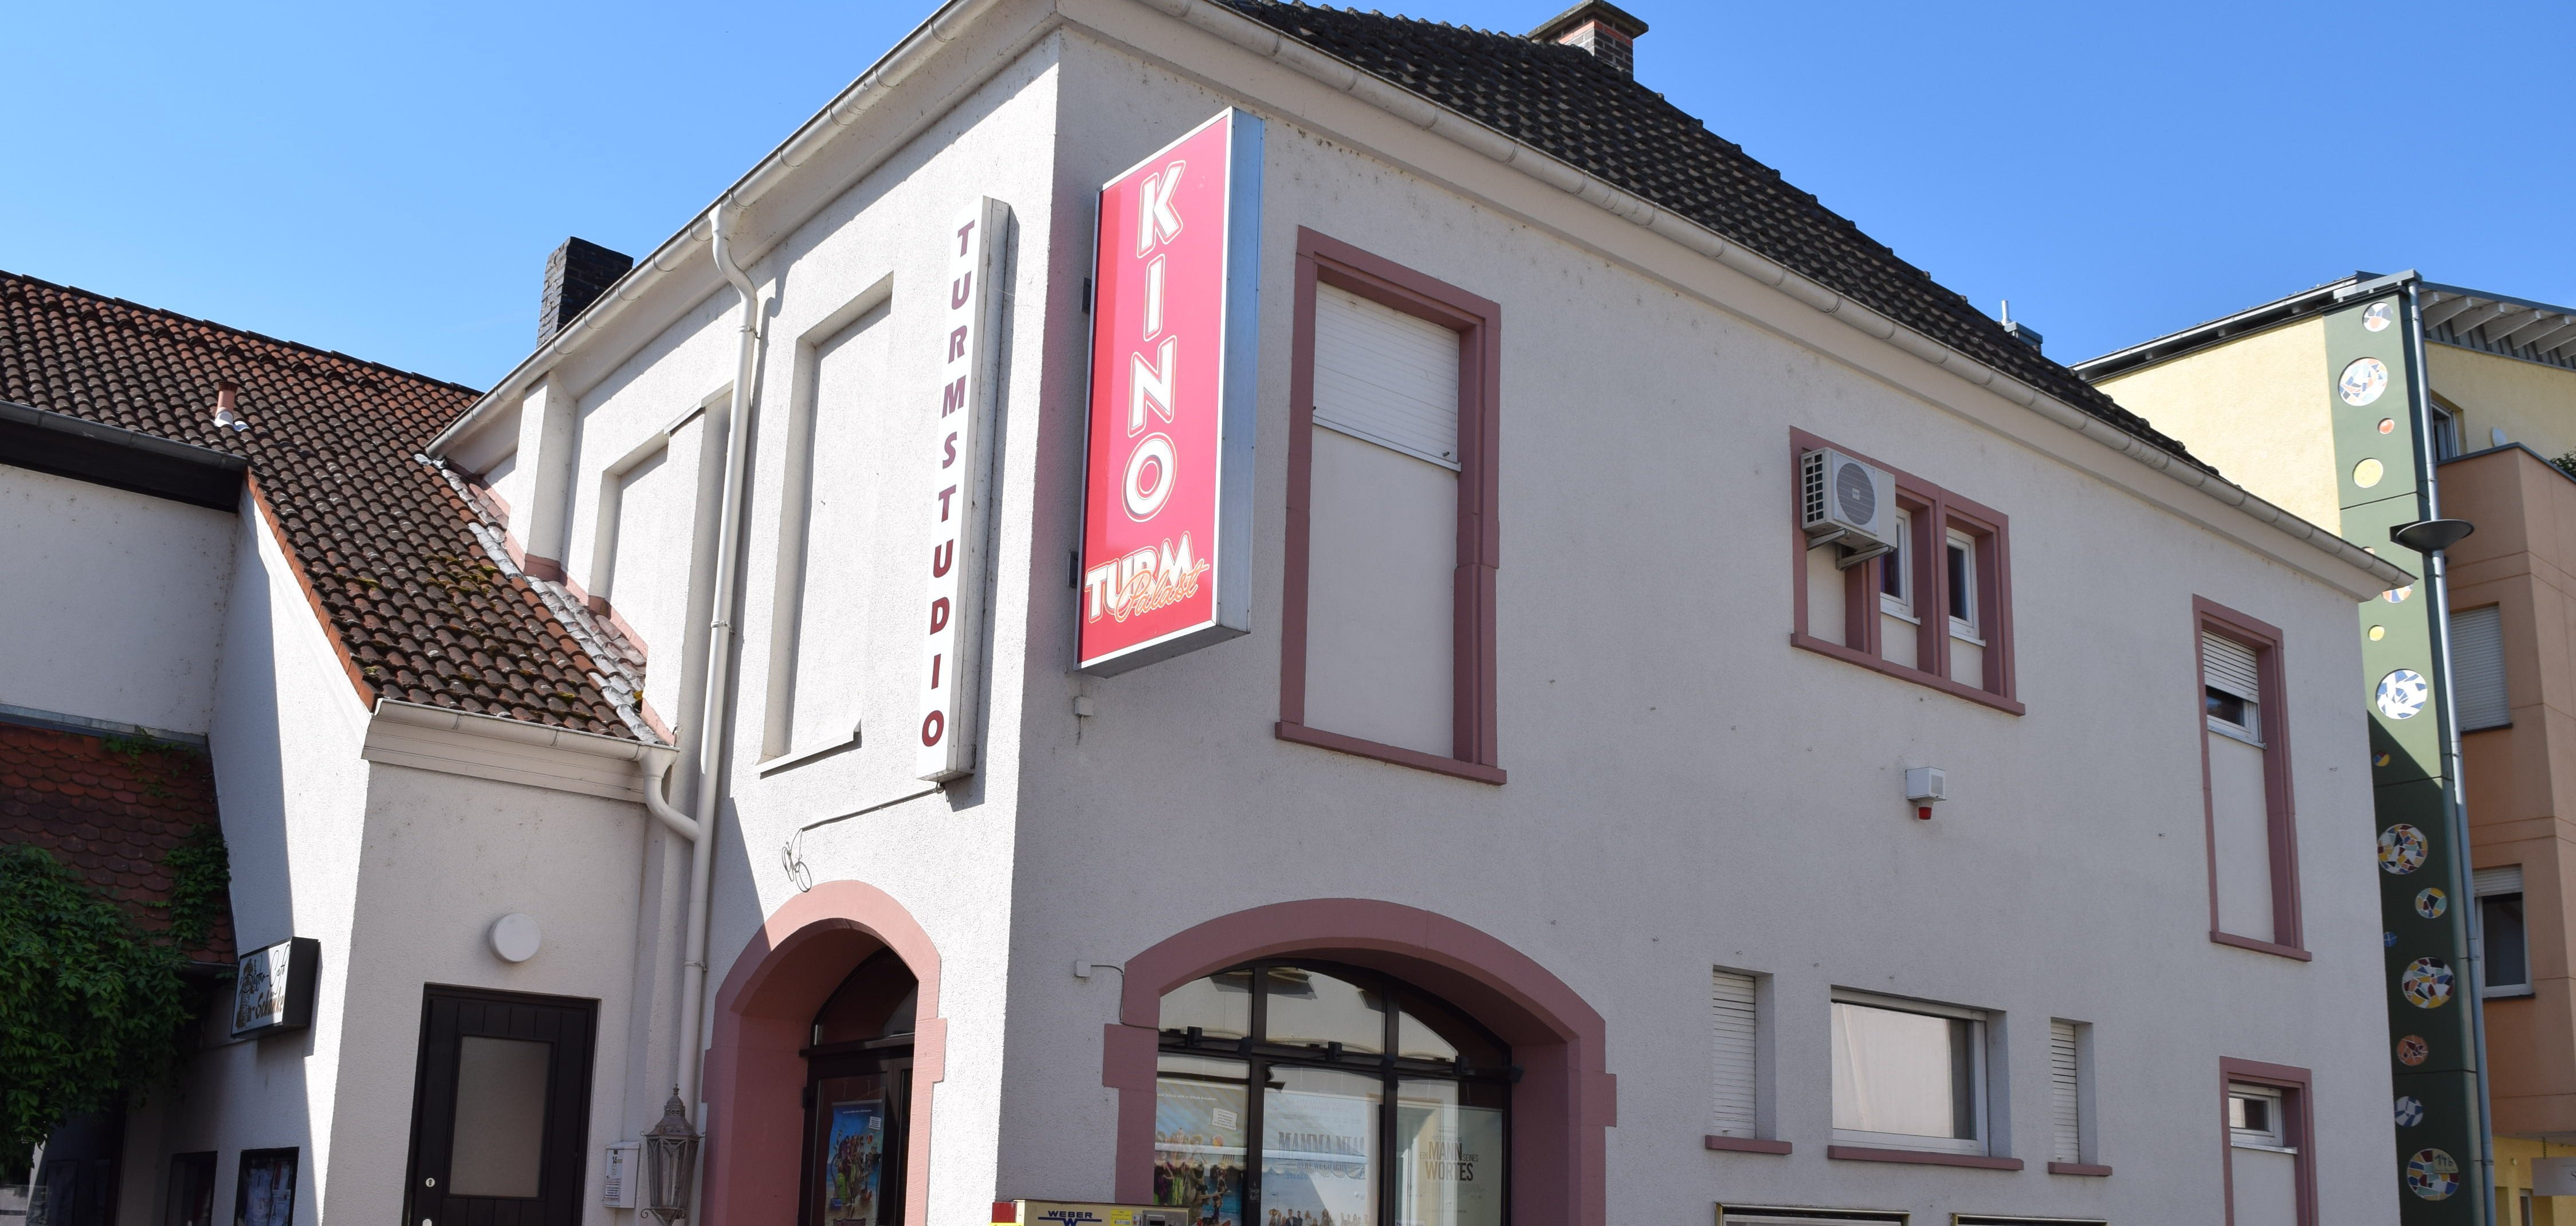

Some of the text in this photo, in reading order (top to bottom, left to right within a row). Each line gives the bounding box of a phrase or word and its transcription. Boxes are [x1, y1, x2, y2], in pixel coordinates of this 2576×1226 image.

[1122, 160, 1185, 522] KINO
[1085, 532, 1195, 622] TURM
[1114, 558, 1210, 623] Palast
[1420, 1141, 1479, 1162] EIN MANN SEINES
[1425, 1161, 1474, 1181] WORTES
[1048, 1210, 1093, 1219] WEBER
